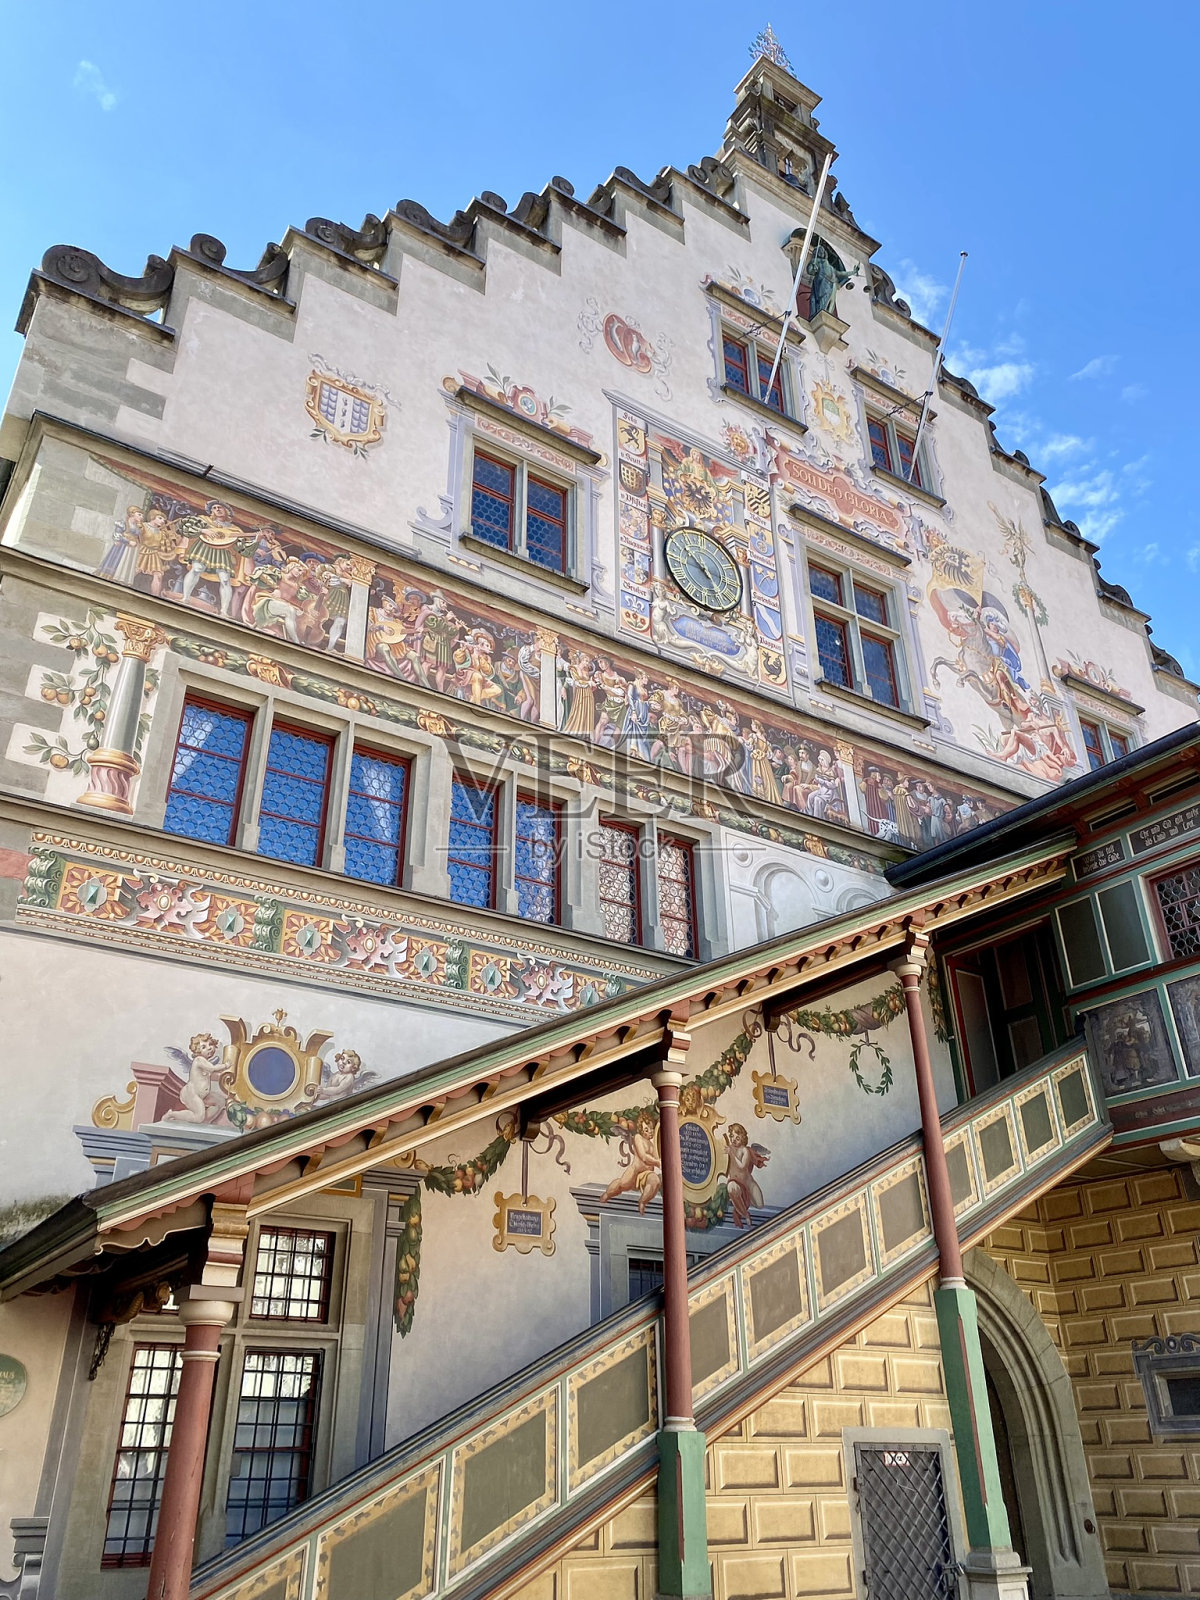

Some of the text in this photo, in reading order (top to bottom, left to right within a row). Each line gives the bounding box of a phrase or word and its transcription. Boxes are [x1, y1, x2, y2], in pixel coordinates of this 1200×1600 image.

[792, 463, 890, 523] SOLI DEO GLORIA
